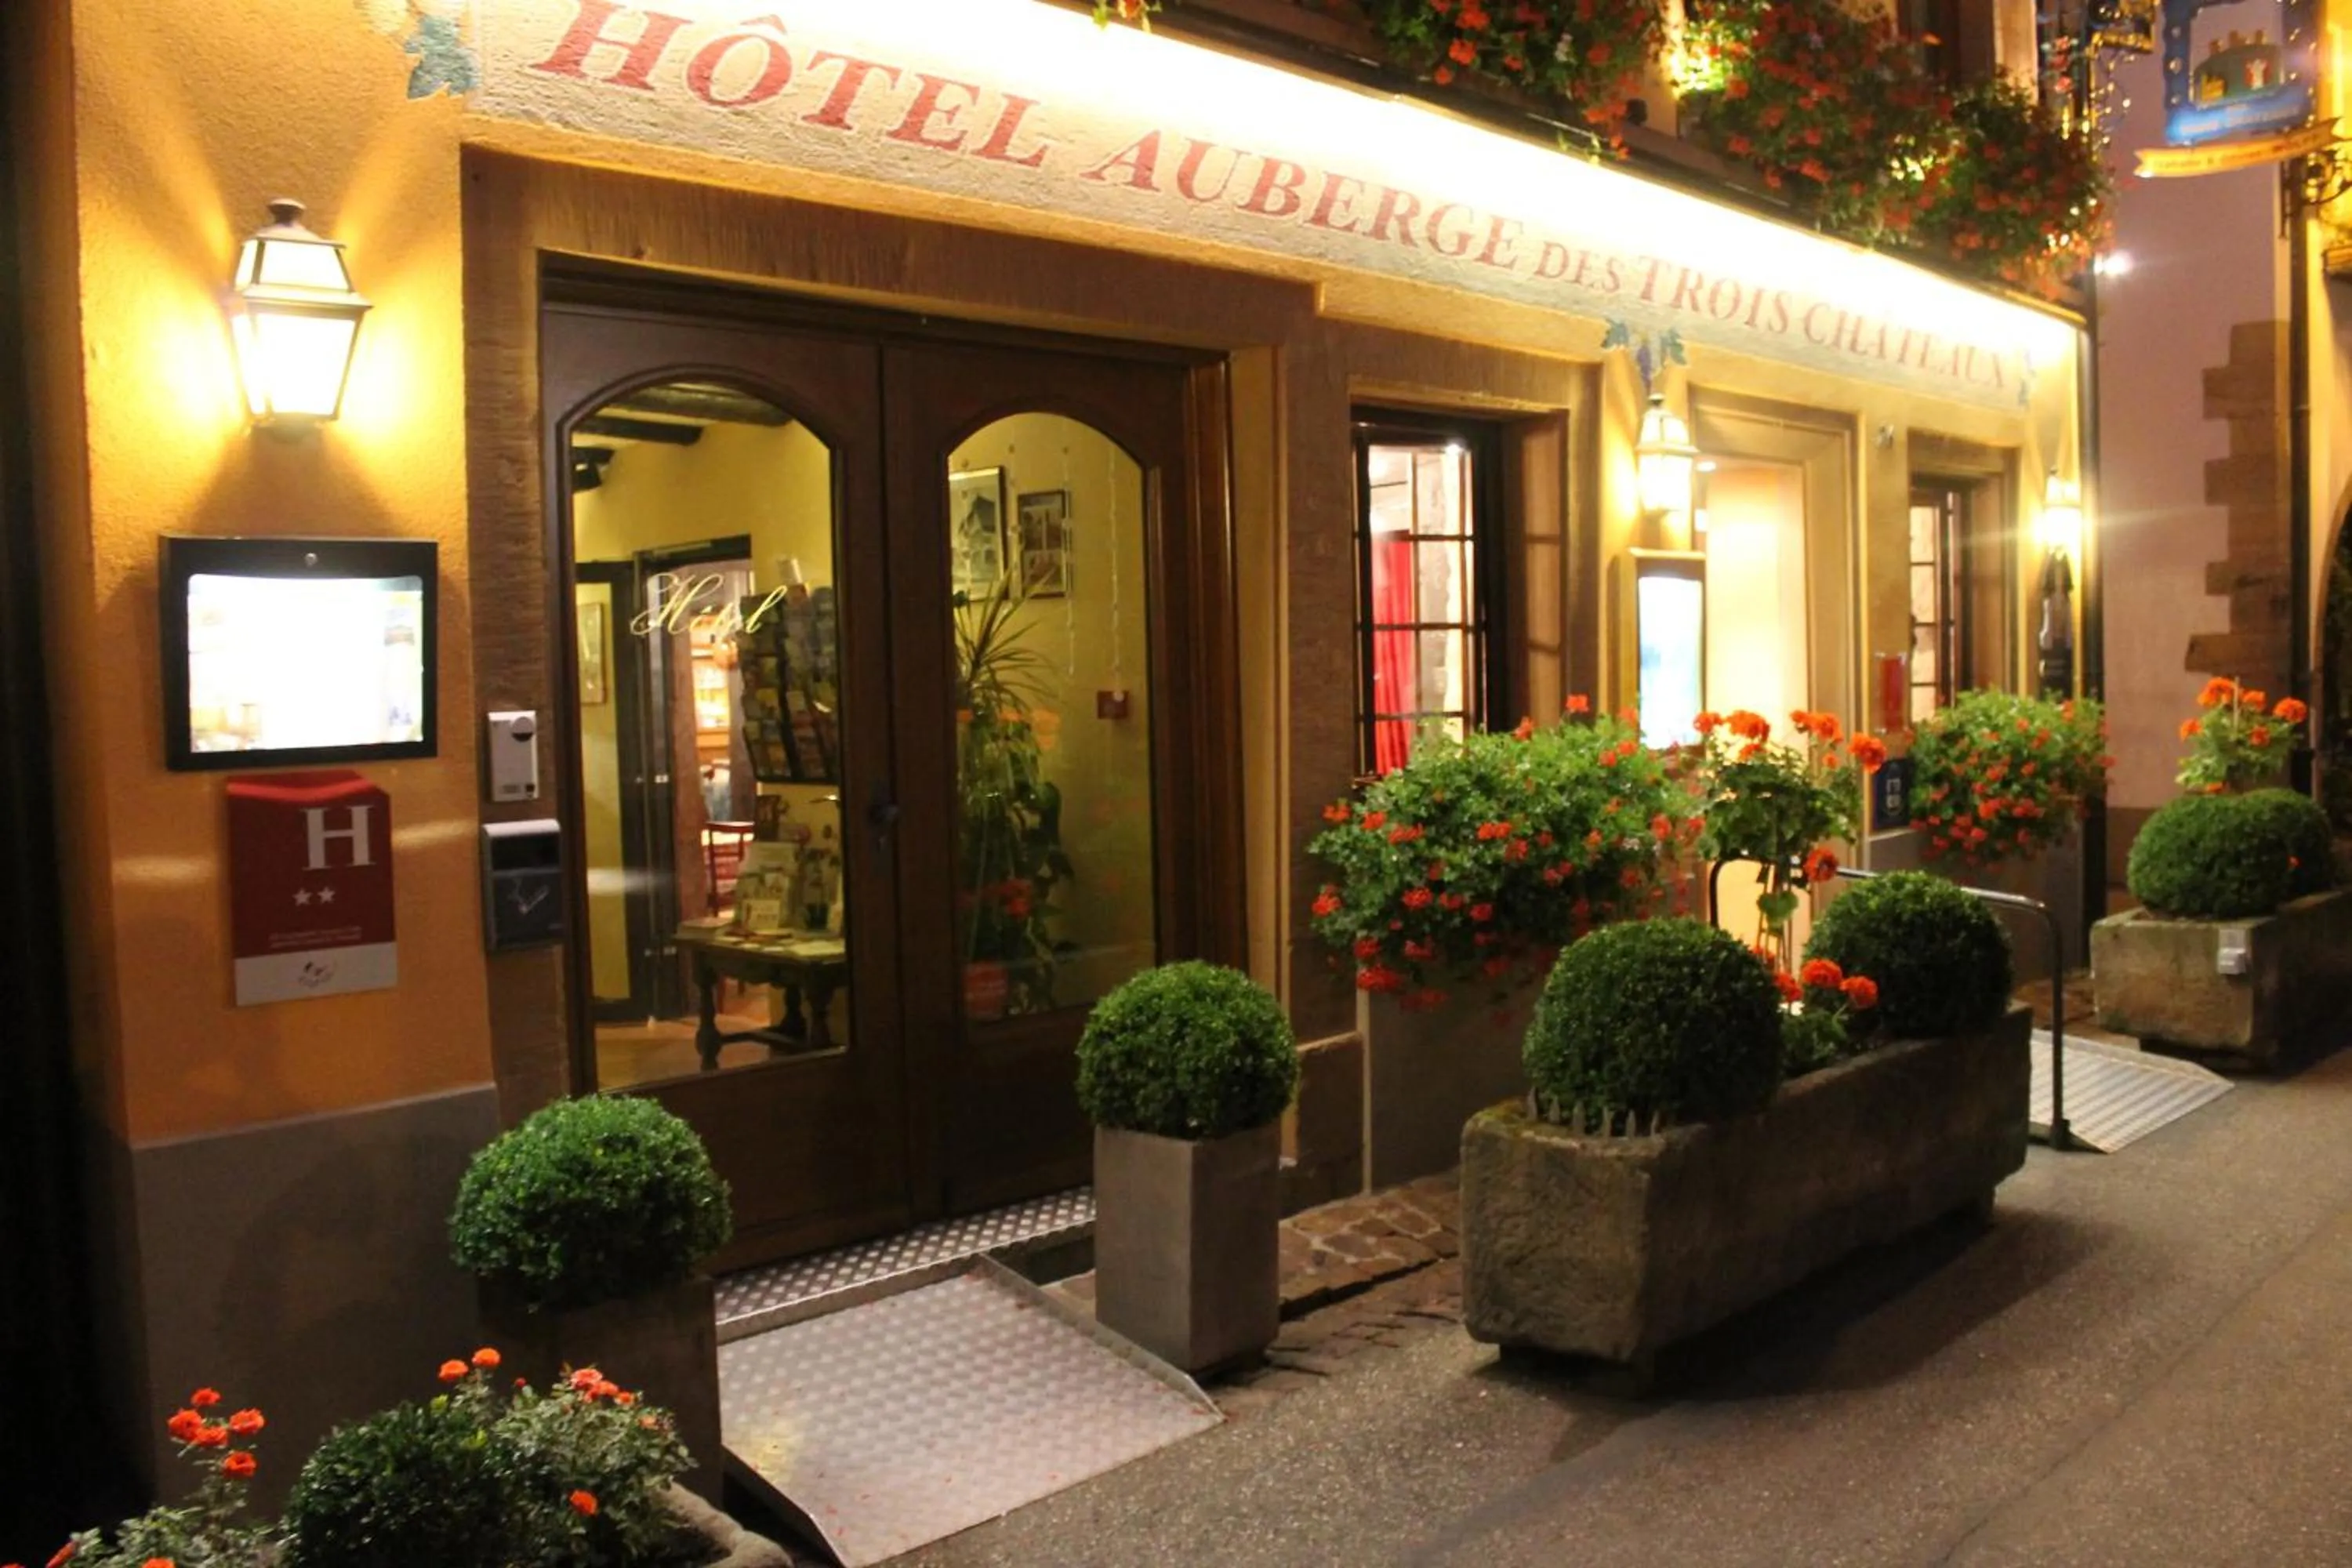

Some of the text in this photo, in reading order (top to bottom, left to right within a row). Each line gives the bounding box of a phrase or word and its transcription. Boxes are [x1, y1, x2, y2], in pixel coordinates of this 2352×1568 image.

[529, 0, 1048, 166] HÔTEL
[1080, 129, 1523, 270] AUBERGE
[1533, 240, 1621, 293] DES
[1639, 255, 1792, 334] TROIS
[299, 805, 376, 869] H
